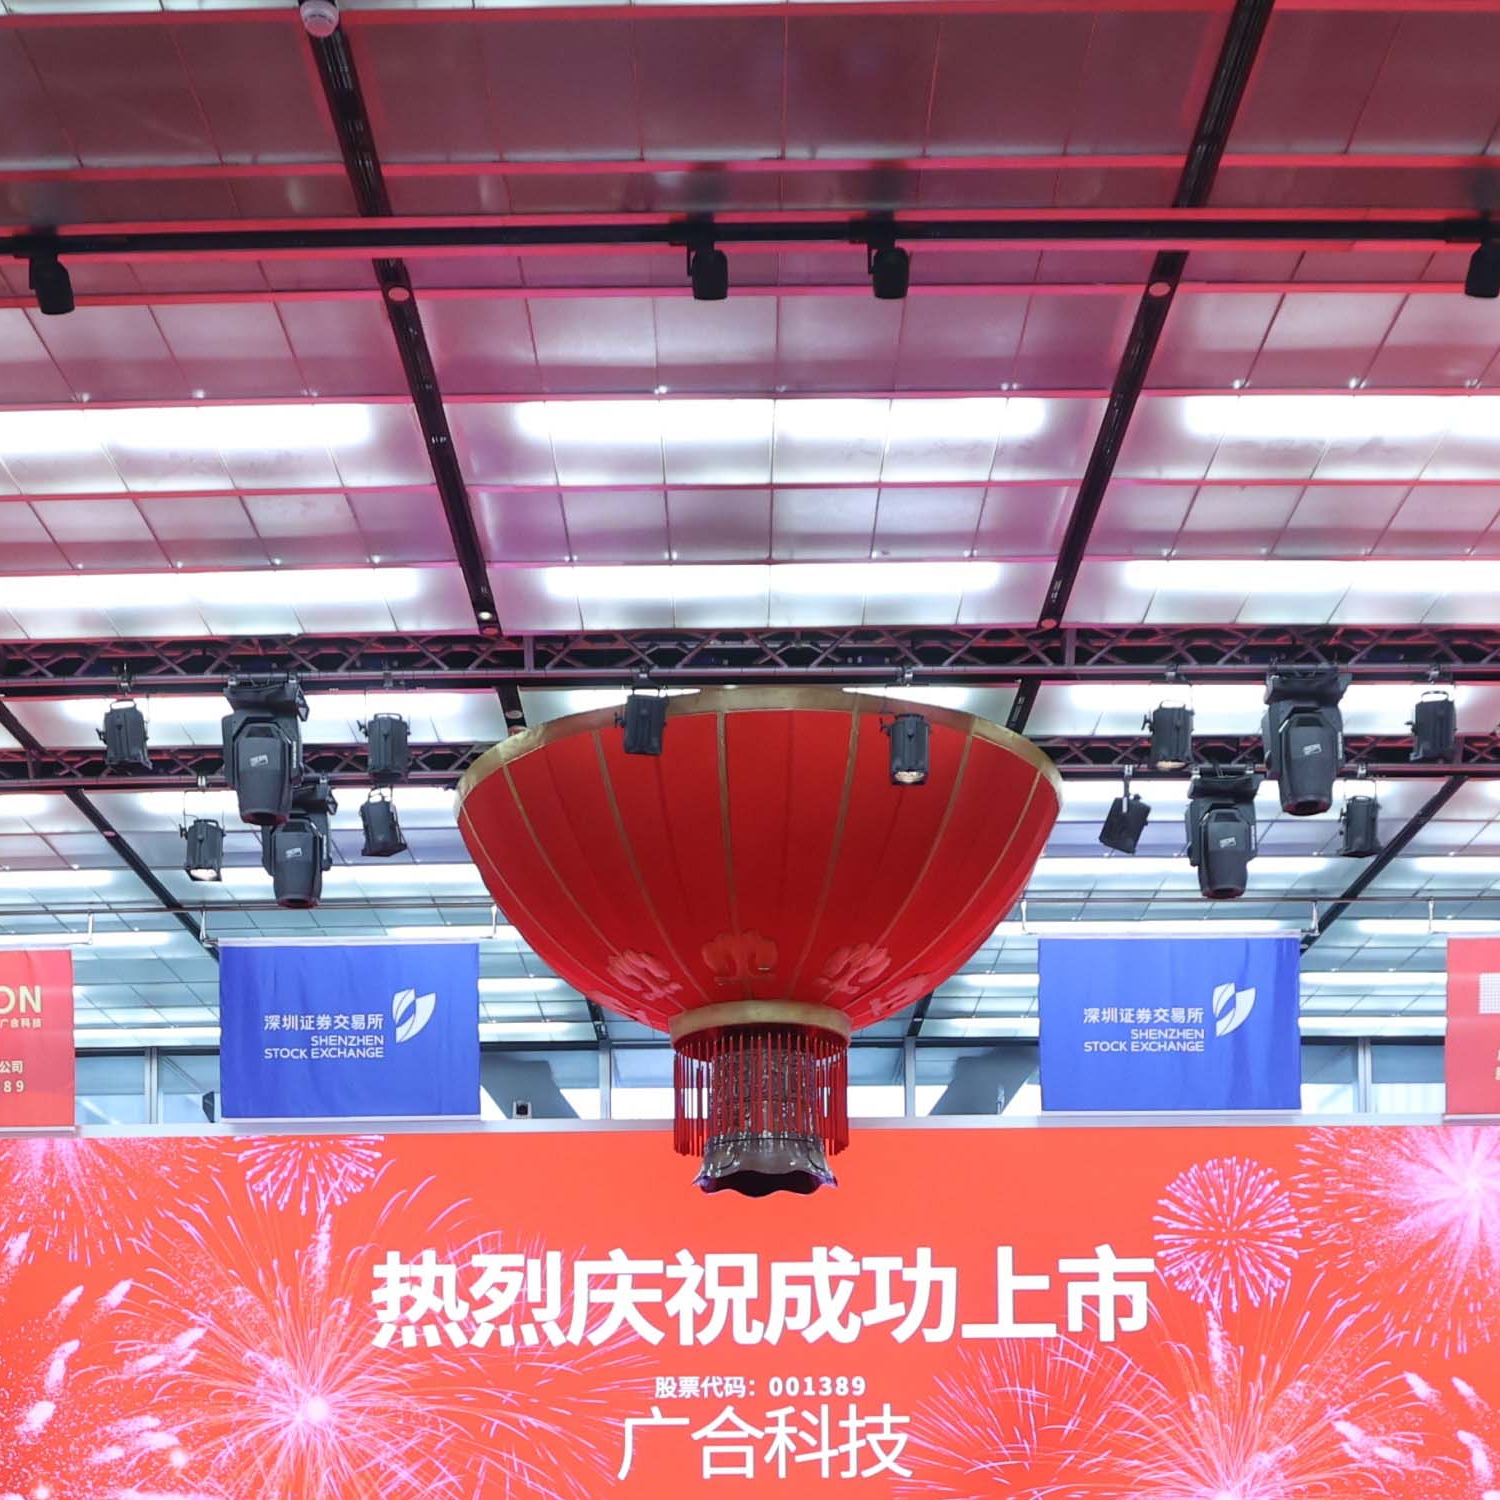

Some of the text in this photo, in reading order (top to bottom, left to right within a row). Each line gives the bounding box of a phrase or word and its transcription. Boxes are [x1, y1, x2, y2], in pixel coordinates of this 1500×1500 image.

[263, 1013, 384, 1031] 深圳证券交易所
[1083, 1007, 1205, 1025] 深圳证券交易所
[0, 1018, 42, 1029] 广合科技
[1130, 1028, 1205, 1040] SHENZHEN
[310, 1035, 384, 1047] SHENZHEN
[1083, 1040, 1205, 1052] STOCK EXCHANGE
[264, 1047, 384, 1060] STOCK EXCHANGE
[371, 1244, 1157, 1348] 热烈庆祝成功上市
[617, 1403, 913, 1481] 广合科技
